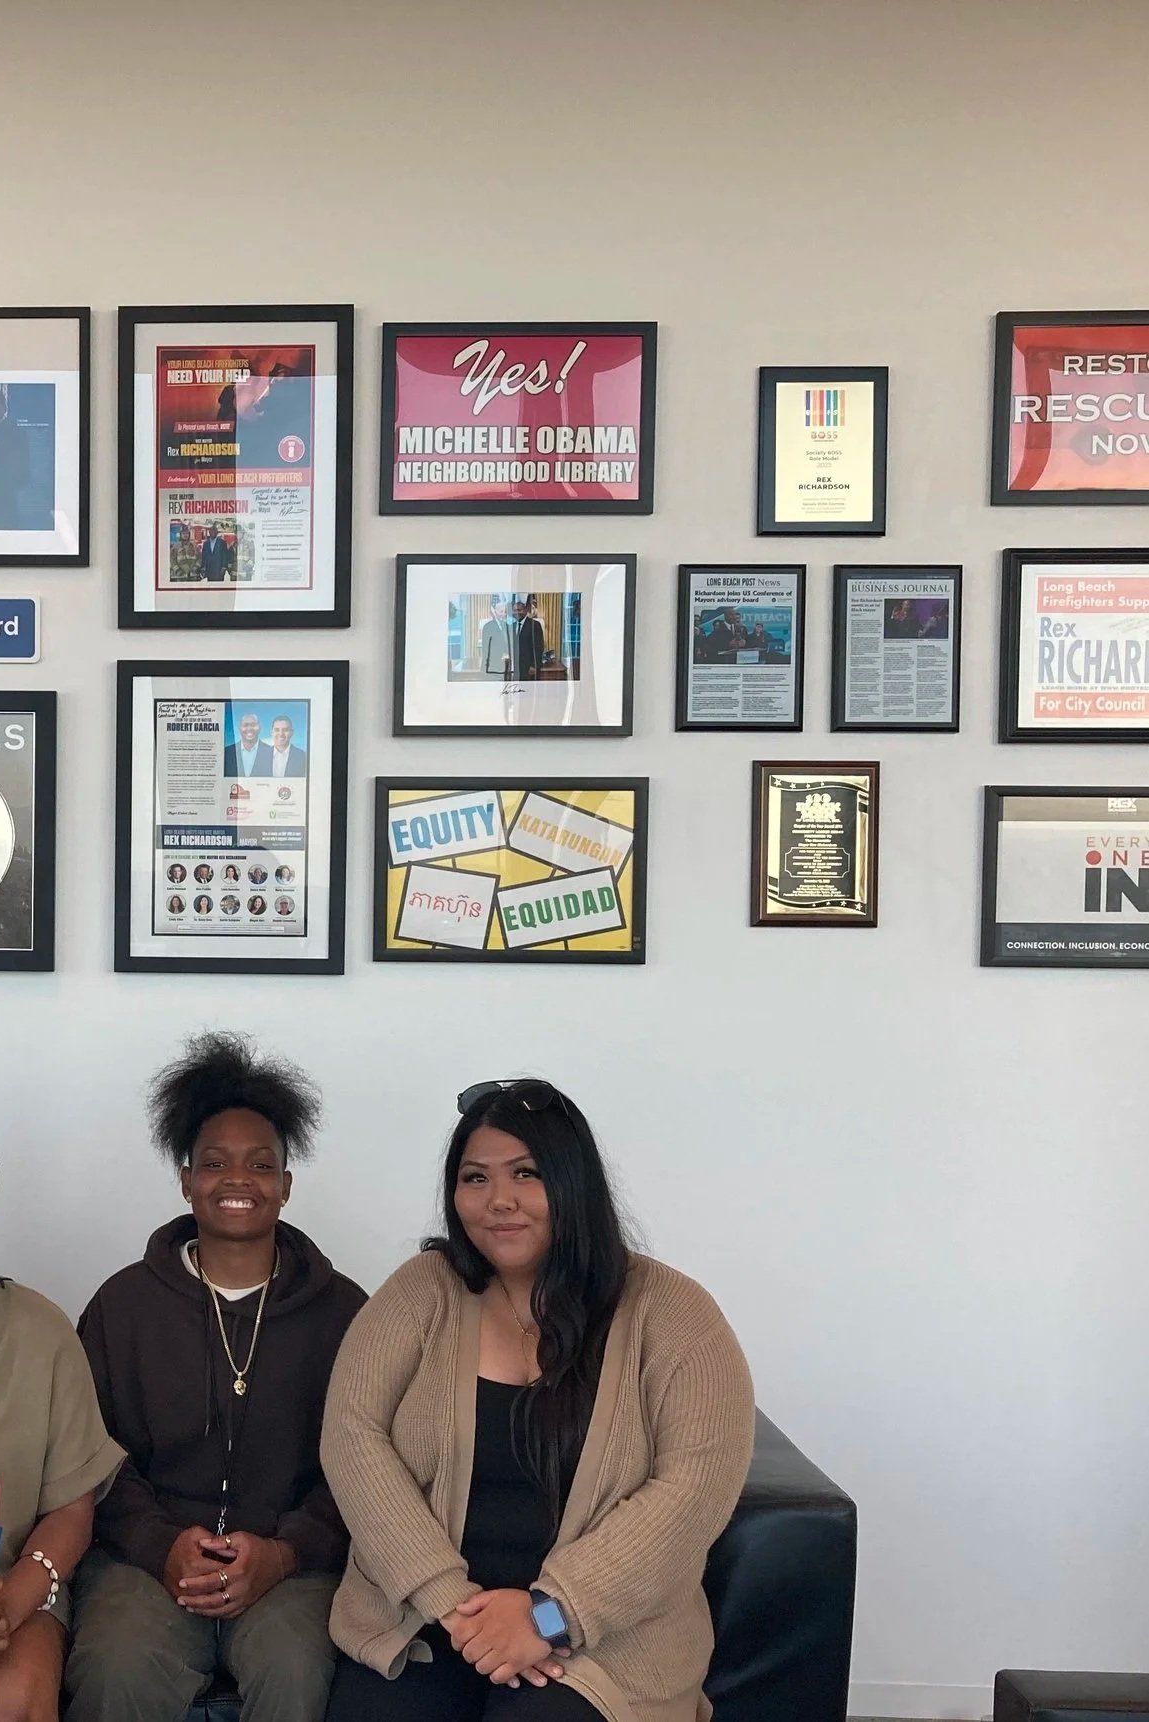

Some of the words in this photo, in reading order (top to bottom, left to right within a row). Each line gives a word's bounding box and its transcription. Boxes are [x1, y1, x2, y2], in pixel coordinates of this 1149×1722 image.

[167, 360, 181, 369] YOUR
[182, 360, 196, 368] LONG
[197, 360, 214, 368] BEACH
[215, 359, 249, 368] FIREFIGHTERS
[167, 370, 193, 384] NEED
[197, 370, 223, 383] YOUR
[225, 369, 251, 383] HELP
[453, 339, 588, 416] Yes!
[399, 426, 529, 454] MICHELLE
[536, 426, 637, 454] OBAMA
[167, 447, 179, 456] Rex
[180, 443, 240, 456] RICHARDSON
[198, 473, 216, 484] YOUR
[217, 473, 234, 483] LONG
[236, 473, 257, 483] BEACH
[258, 472, 303, 483] FIREFIGHTERS
[398, 461, 550, 483] NEIGHBORHOOD
[554, 461, 636, 483] LIBRARY
[169, 501, 184, 514] REX
[185, 500, 248, 514] RICHARDSON
[707, 578, 721, 586] LONG
[723, 578, 740, 586] BEACH
[742, 578, 756, 586] POST
[758, 578, 781, 587] News
[852, 584, 899, 592] BUSINESS
[902, 584, 950, 592] JOURNAL
[1043, 581, 1073, 594] Long
[1078, 581, 1115, 592] Beach
[1043, 596, 1114, 609] Firefighters
[1040, 616, 1076, 638] Rex
[1040, 696, 1061, 711] For
[1065, 696, 1092, 715] City
[1096, 696, 1145, 711] Council
[167, 723, 192, 731] ROBERT
[194, 723, 219, 731] GARCIA
[1107, 798, 1137, 809] REX
[391, 802, 495, 853] EQUITY
[164, 835, 180, 846] REX
[181, 835, 232, 846] RICHARDSON
[517, 813, 623, 865] KATARUNGAN
[503, 886, 615, 931] EQUIDAD
[1006, 941, 1068, 949] CONNECTION.
[1068, 942, 1118, 950] INCLUSION.
